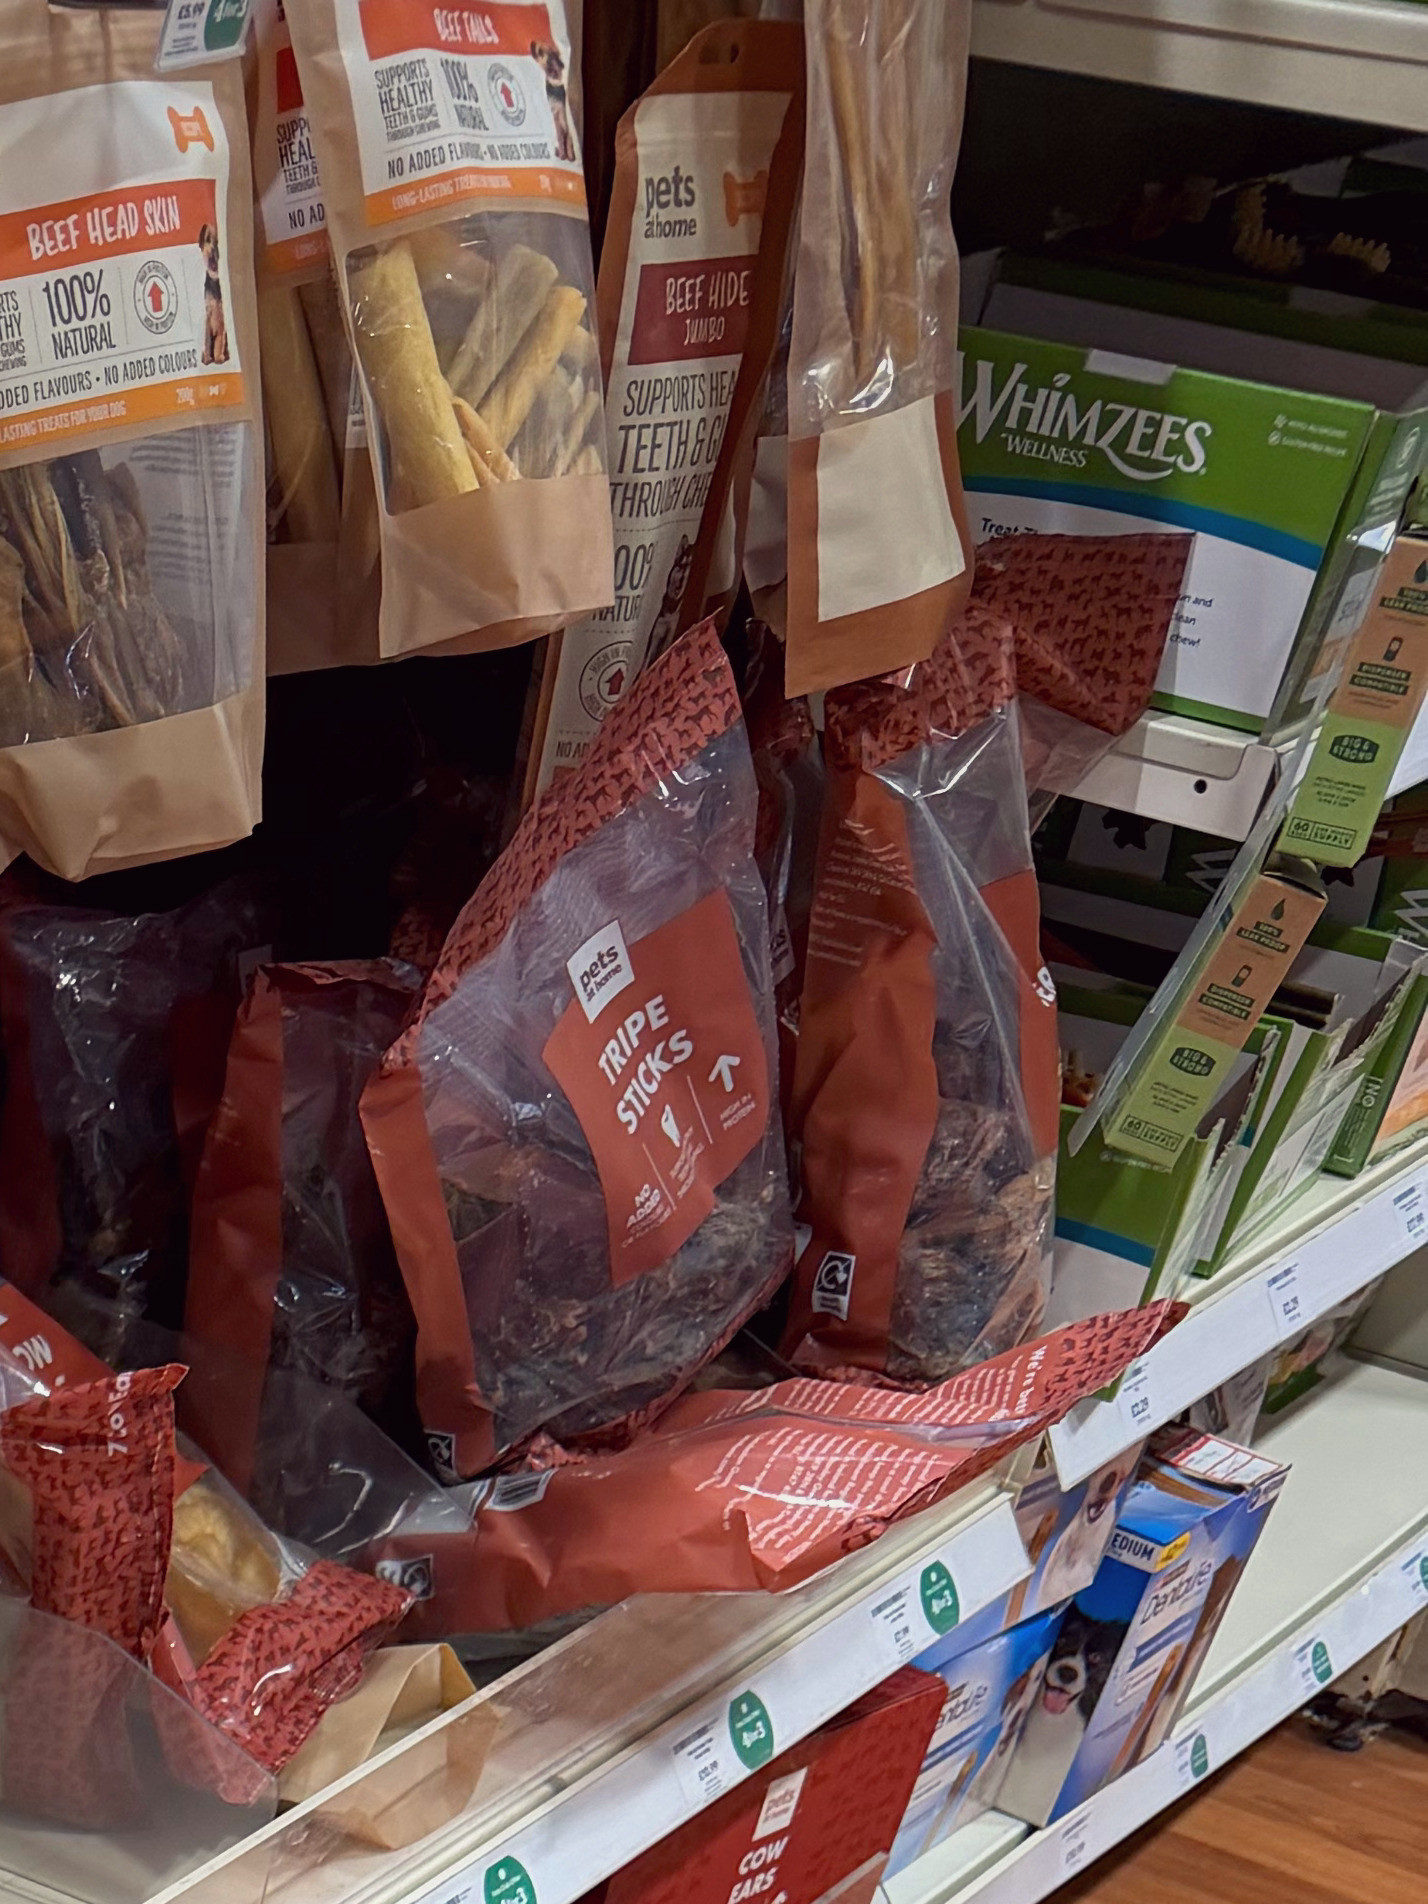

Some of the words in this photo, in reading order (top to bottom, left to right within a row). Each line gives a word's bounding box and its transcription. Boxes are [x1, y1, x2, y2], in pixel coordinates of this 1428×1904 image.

[374, 58, 430, 90] SUPPORTS
[378, 79, 434, 114] HEALTHY
[387, 159, 403, 179] NO
[409, 146, 445, 174] ADDED
[645, 165, 695, 218] pets
[27, 213, 81, 261] BEEF
[86, 202, 139, 247] HEAD
[143, 196, 181, 236] SKIN
[42, 268, 111, 327] 100%
[666, 273, 703, 315] BEEF
[709, 271, 751, 310] HIDE
[50, 321, 117, 360] NATURAL
[34, 371, 93, 402] FLAVOURS
[104, 365, 118, 387] NO
[122, 356, 155, 384] ADDED
[158, 349, 198, 375] COLOURS
[623, 373, 705, 417] SUPPORTS
[618, 421, 691, 474] TEETH
[1001, 432, 1088, 468] WELLNESS
[579, 945, 619, 992] pets
[598, 994, 669, 1086] TRIPE
[616, 1029, 694, 1135] STICKS
[1111, 1532, 1154, 1561] EDIUM
[738, 1836, 789, 1875] COW
